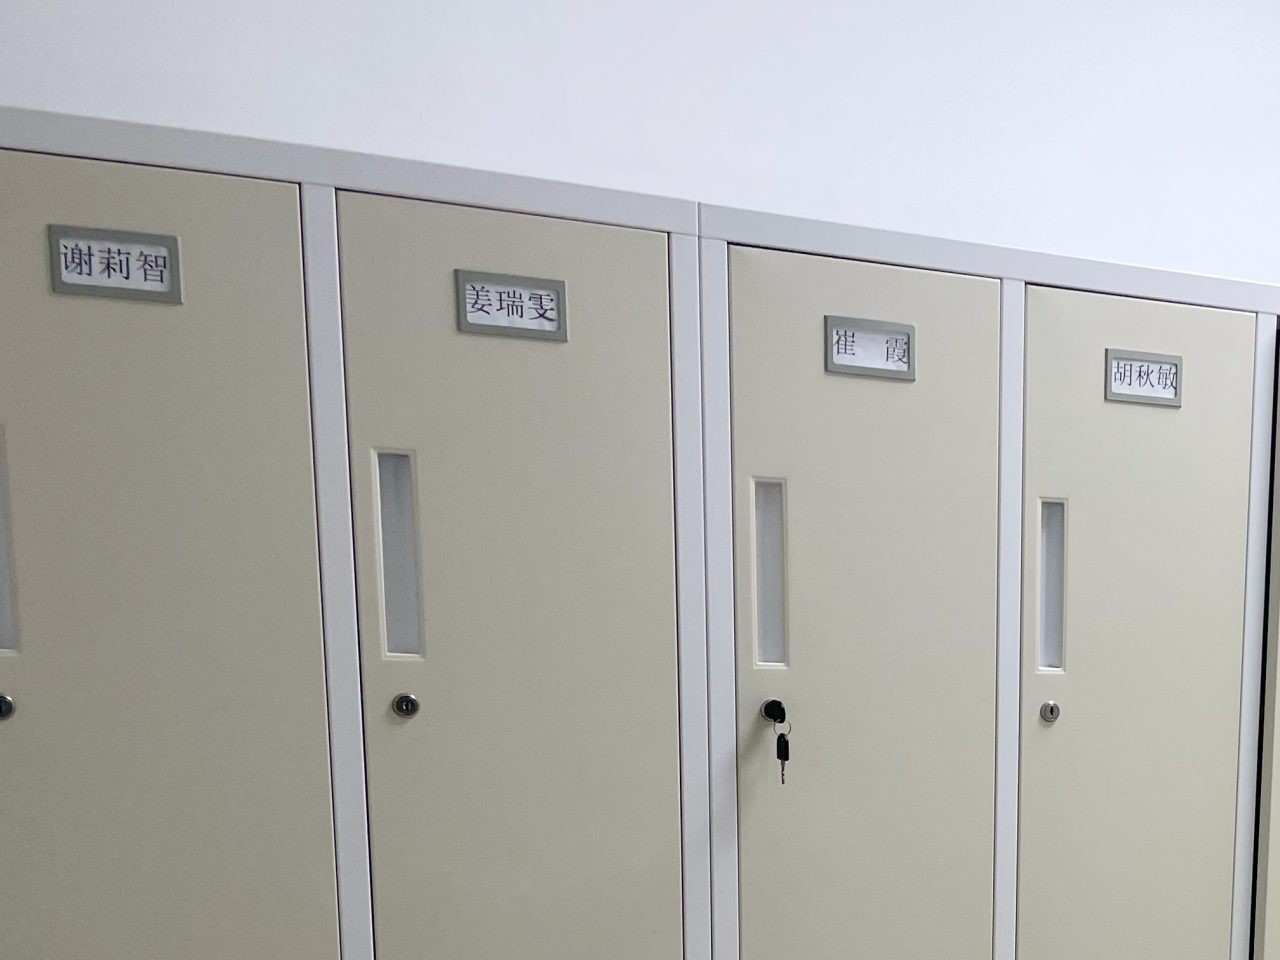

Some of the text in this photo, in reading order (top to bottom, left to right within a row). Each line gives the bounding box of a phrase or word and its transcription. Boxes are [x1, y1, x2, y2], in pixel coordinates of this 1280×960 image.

[61, 243, 167, 284] 谢莉智
[466, 285, 557, 323] 姜瑞雯
[1113, 362, 1177, 391] 胡秋敏
